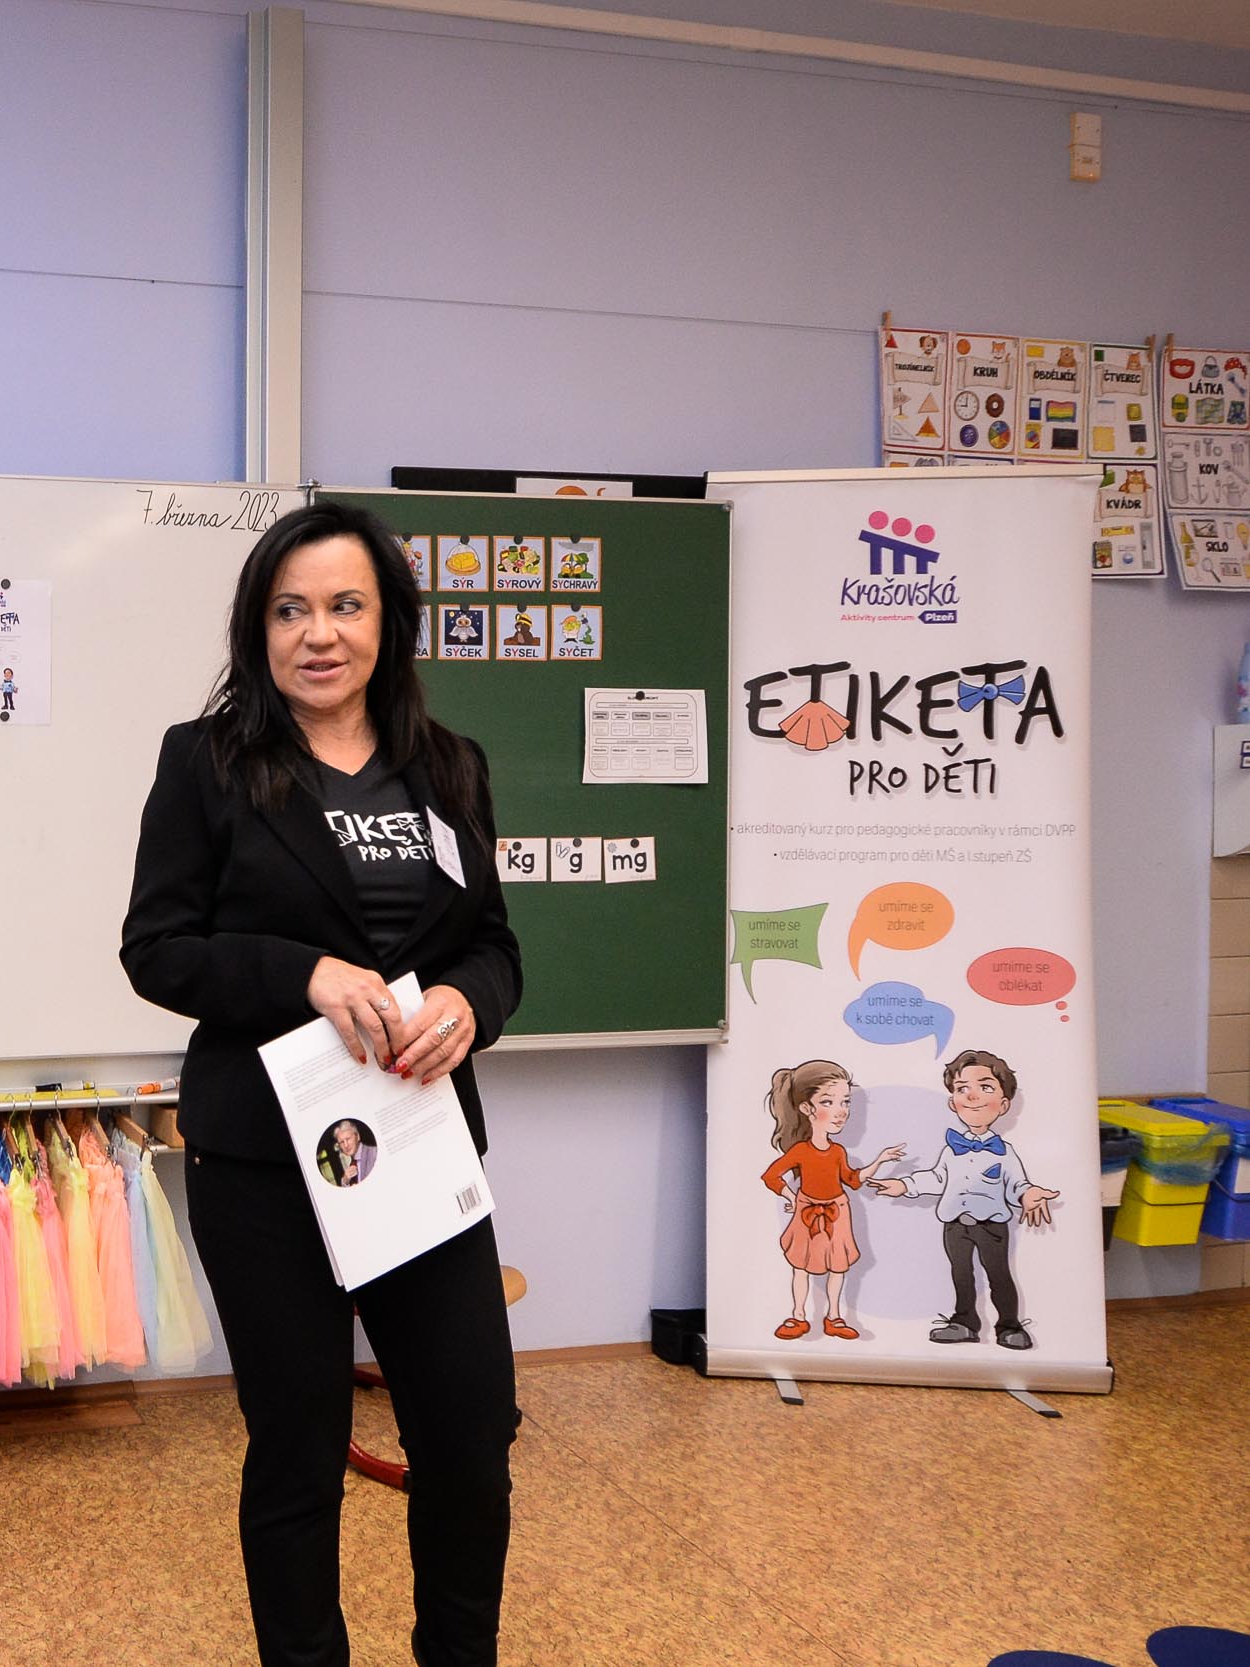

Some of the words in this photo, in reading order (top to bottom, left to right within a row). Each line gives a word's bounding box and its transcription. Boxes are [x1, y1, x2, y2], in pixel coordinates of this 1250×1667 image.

[973, 365, 999, 378] KRUH
[1103, 370, 1141, 384] ČTVEREC
[1188, 379, 1225, 396] LÁTKA
[1198, 463, 1219, 475] KOV
[1105, 496, 1142, 510] KVÁDR
[230, 489, 280, 532] 2023
[1205, 541, 1229, 553] SKLO
[452, 576, 474, 589] SÝR
[497, 577, 542, 589] SYROVÝ
[552, 577, 598, 590] SYCHRAVÝ
[841, 575, 960, 606] Krašovská
[840, 614, 875, 623] Aktivity
[445, 645, 482, 658] SÝČEK
[504, 648, 539, 658] SYSEL
[558, 645, 595, 658] SYČET
[744, 659, 1065, 750] ETIKETA
[849, 760, 908, 796] PRO
[923, 742, 996, 795] DĚTI
[324, 810, 433, 847] TIKET
[737, 822, 807, 838] akreditovaný
[809, 823, 833, 835] kurz
[835, 825, 855, 838] pro
[857, 823, 932, 839] pedagogické
[933, 823, 997, 839] pracovníky
[999, 826, 1006, 836] v
[1007, 824, 1043, 836] rámci
[1045, 823, 1077, 837] DVPP
[357, 845, 392, 861] PRO
[779, 848, 837, 861] vzdělávací
[839, 850, 887, 863] program
[889, 851, 910, 863] pro
[911, 849, 934, 862] děti
[958, 852, 966, 862] a
[507, 848, 535, 874] kg
[569, 851, 583, 873] g
[612, 851, 647, 873] mg
[878, 900, 918, 913] umíme
[919, 902, 934, 913] se
[748, 919, 786, 931] umíme
[787, 920, 800, 931] se
[886, 918, 926, 932] zdravit
[750, 937, 799, 950] stravovat
[992, 960, 1033, 974] umíme
[1035, 962, 1050, 974] se
[998, 978, 1044, 992] oblékat
[868, 994, 908, 1008] umíme
[909, 996, 923, 1008] se
[856, 1012, 864, 1025] k
[865, 1012, 894, 1026] sobě
[895, 1013, 935, 1026] chovat
